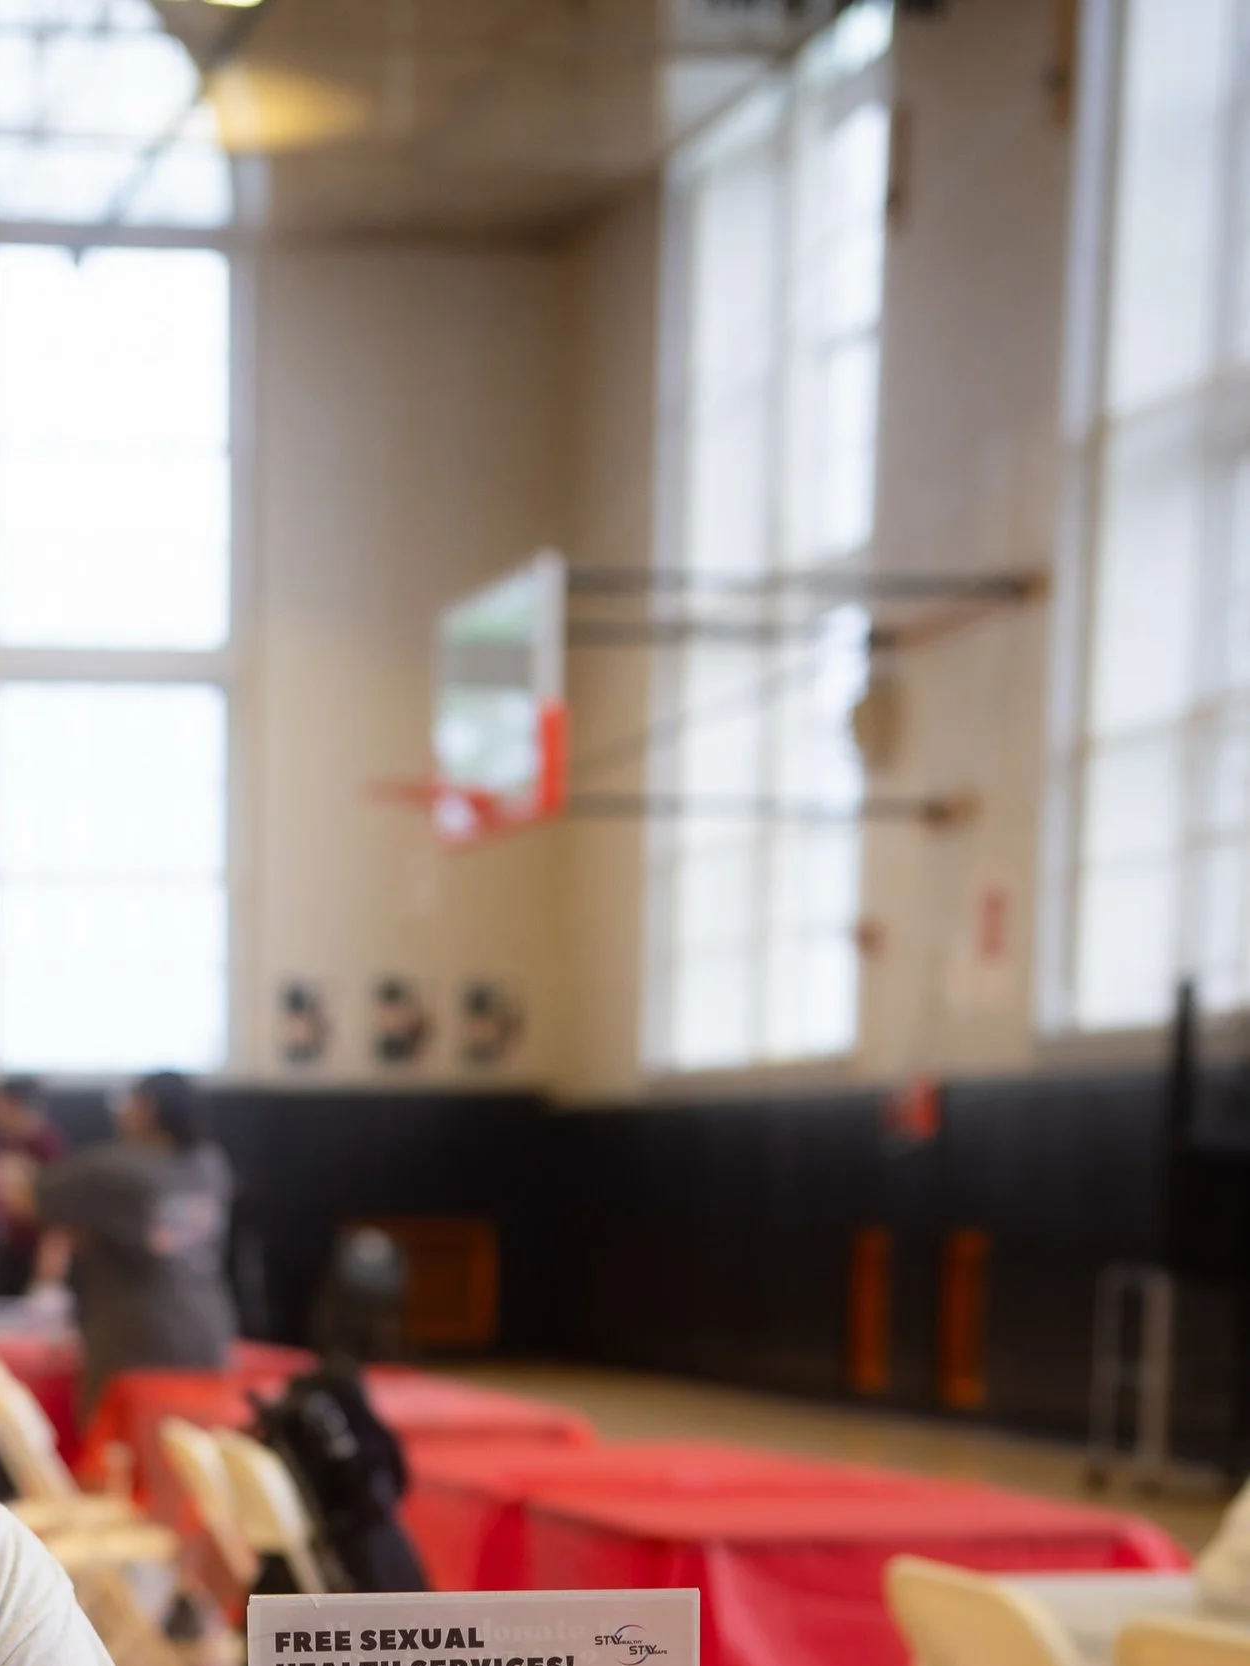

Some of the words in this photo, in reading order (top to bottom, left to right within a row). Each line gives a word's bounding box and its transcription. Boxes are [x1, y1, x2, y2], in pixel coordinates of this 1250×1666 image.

[275, 1631, 351, 1652] FREE
[360, 1627, 484, 1650] SEXUAL
[595, 1635, 623, 1645] STAY
[629, 1645, 657, 1655] STAY
